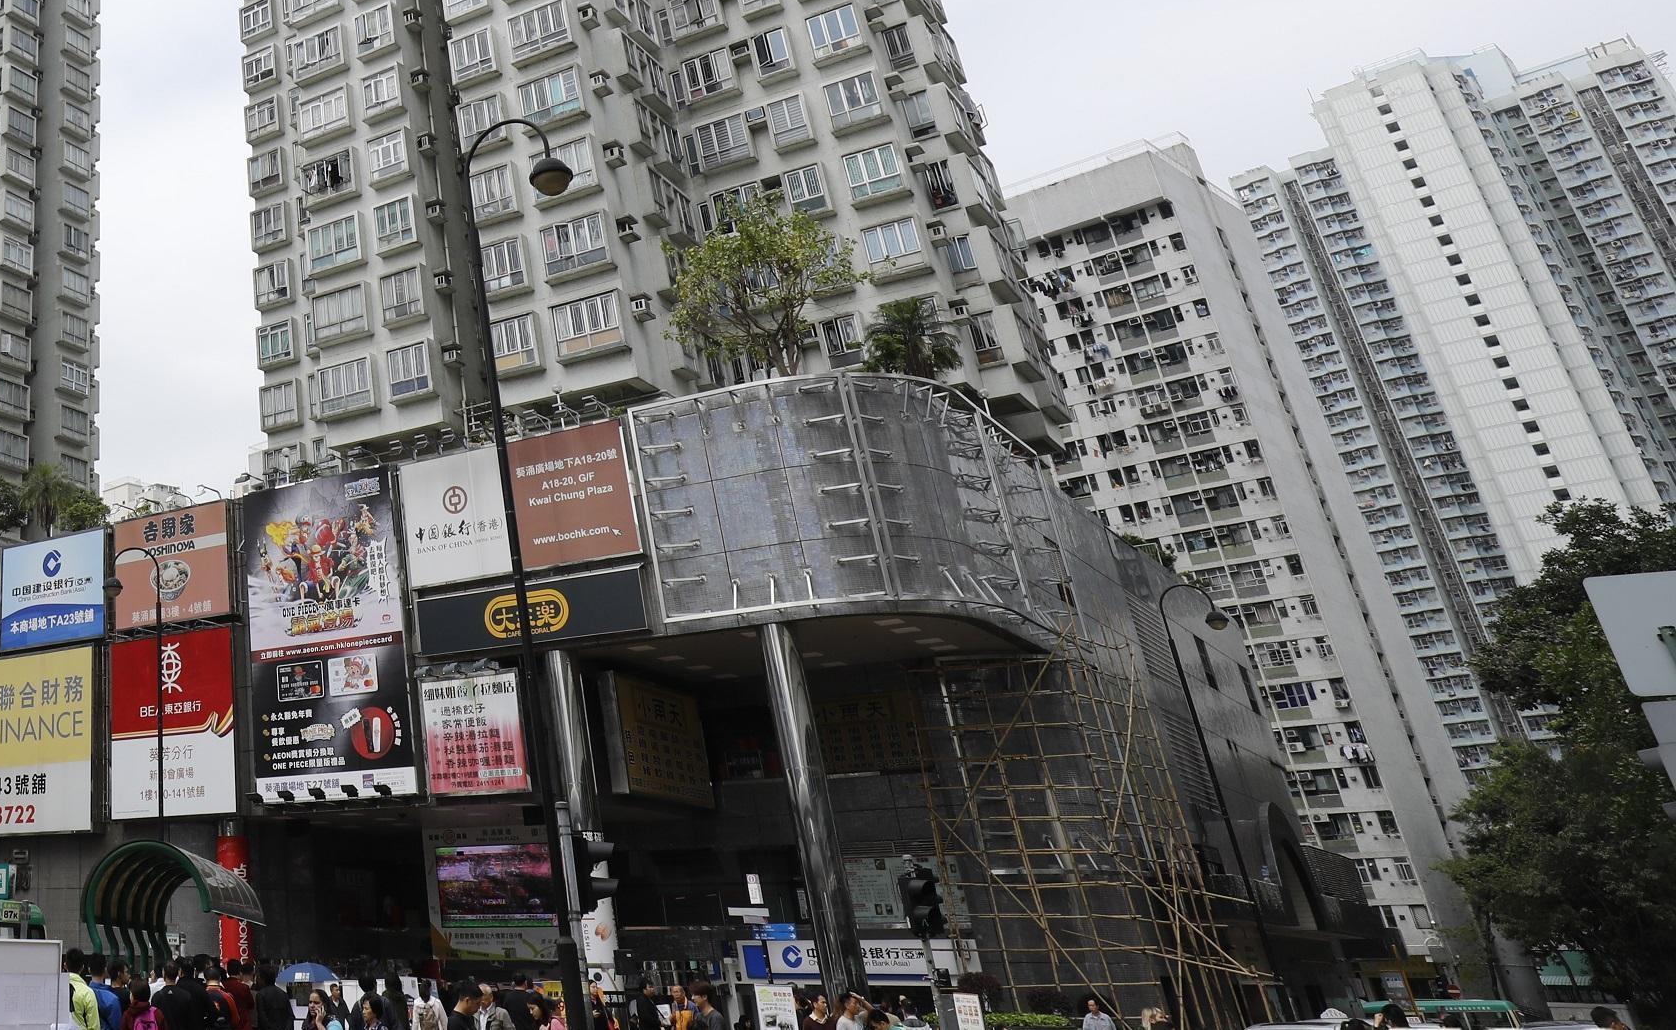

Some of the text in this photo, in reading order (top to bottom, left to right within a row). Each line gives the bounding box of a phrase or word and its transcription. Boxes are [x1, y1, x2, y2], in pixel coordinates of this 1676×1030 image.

[516, 448, 617, 478] 葵涌廣場地下A18-20號
[541, 472, 595, 490] A18-20, G/F
[529, 484, 614, 507] Kwai Chung Plaza
[414, 517, 503, 545] 中國銀行(香港)
[533, 525, 610, 547] www.bochk.com
[417, 545, 437, 555] BANK
[438, 544, 448, 552] OF
[449, 539, 473, 550] CHINA
[32, 591, 59, 600] Construction
[72, 586, 86, 594] (Asia)
[282, 606, 296, 618] ONE
[297, 603, 317, 616] PIECE
[10, 608, 94, 635] 本商場地下A23號舖
[530, 627, 551, 635] CORAL
[260, 634, 393, 660] 立即前往 www.aeon.com.hk/onepiececard
[164, 700, 202, 715] 東亞銀行
[441, 703, 486, 717] 過橋餃子
[270, 709, 312, 722] 永久豁免年費
[442, 717, 488, 730] 家常便飯
[272, 761, 287, 771] ONE
[140, 785, 205, 802] 1樓10-141號舖
[3, 910, 18, 919] 87K
[583, 923, 591, 951] SUSHI
[891, 959, 911, 968] (Asia)
